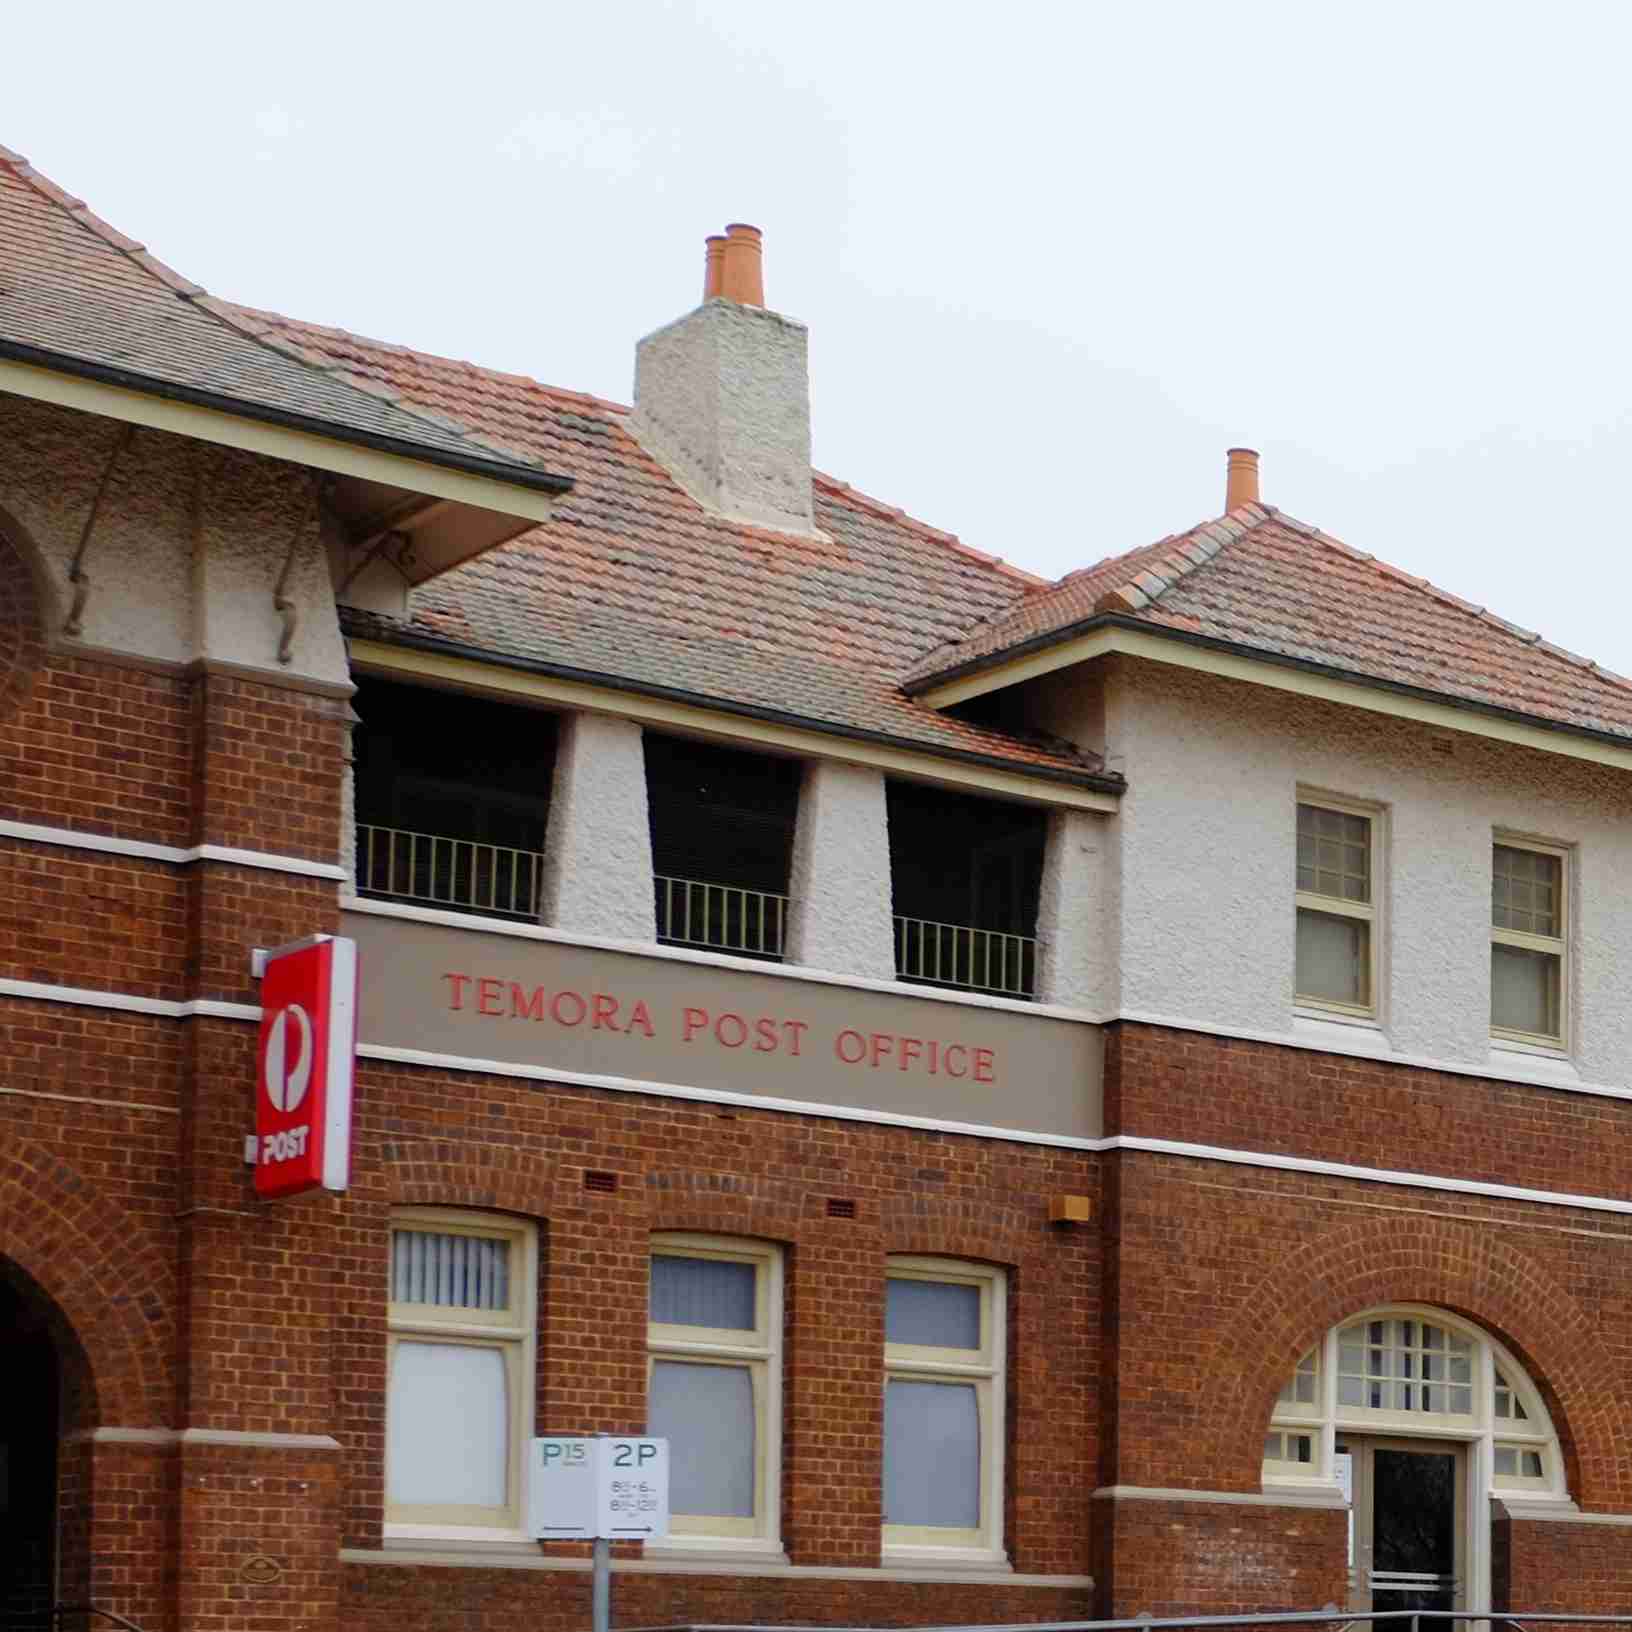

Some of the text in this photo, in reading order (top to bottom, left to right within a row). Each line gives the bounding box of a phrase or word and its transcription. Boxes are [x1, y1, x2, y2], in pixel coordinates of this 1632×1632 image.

[442, 973, 996, 1083] TEMORA POST OFFICE
[262, 1125, 310, 1165] POST
[614, 1443, 657, 1467] 2P
